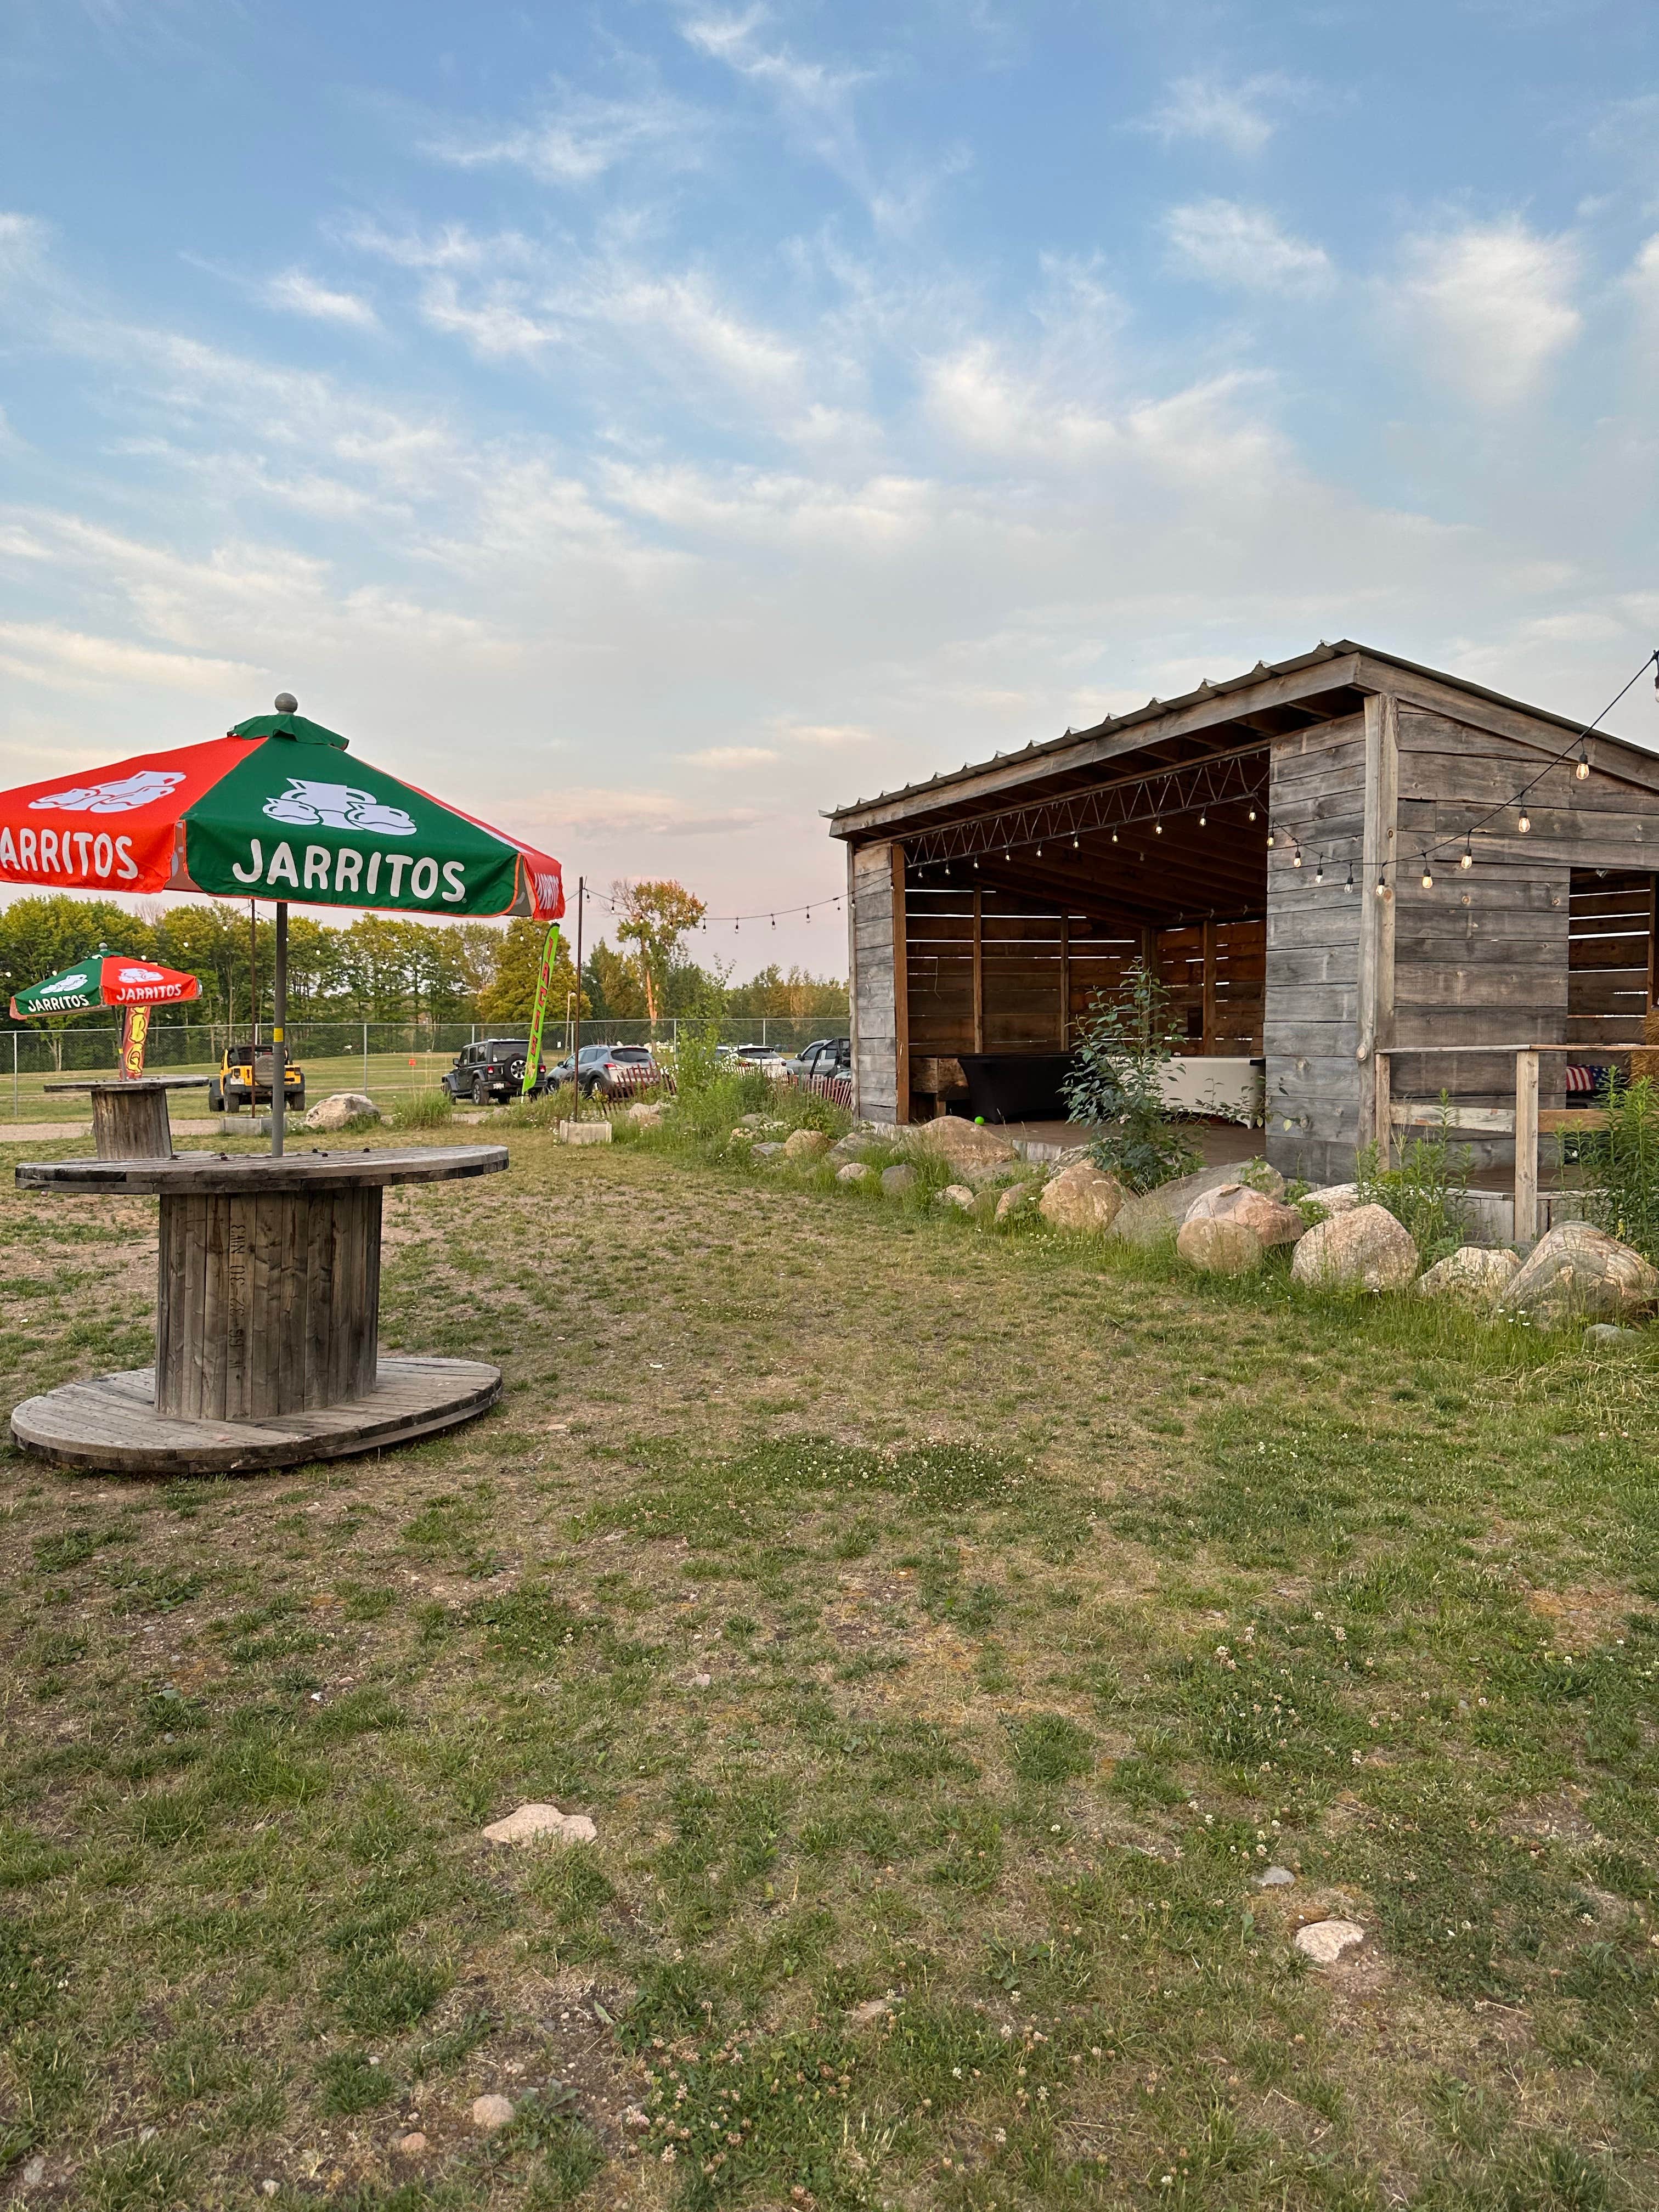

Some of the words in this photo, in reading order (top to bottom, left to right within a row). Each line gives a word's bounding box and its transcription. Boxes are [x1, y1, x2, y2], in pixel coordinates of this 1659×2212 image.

[0, 826, 138, 879] ARRITOS
[232, 838, 466, 902] JARRITOS
[27, 994, 89, 1012] JARRITOS
[116, 984, 182, 1001] JARRITOS
